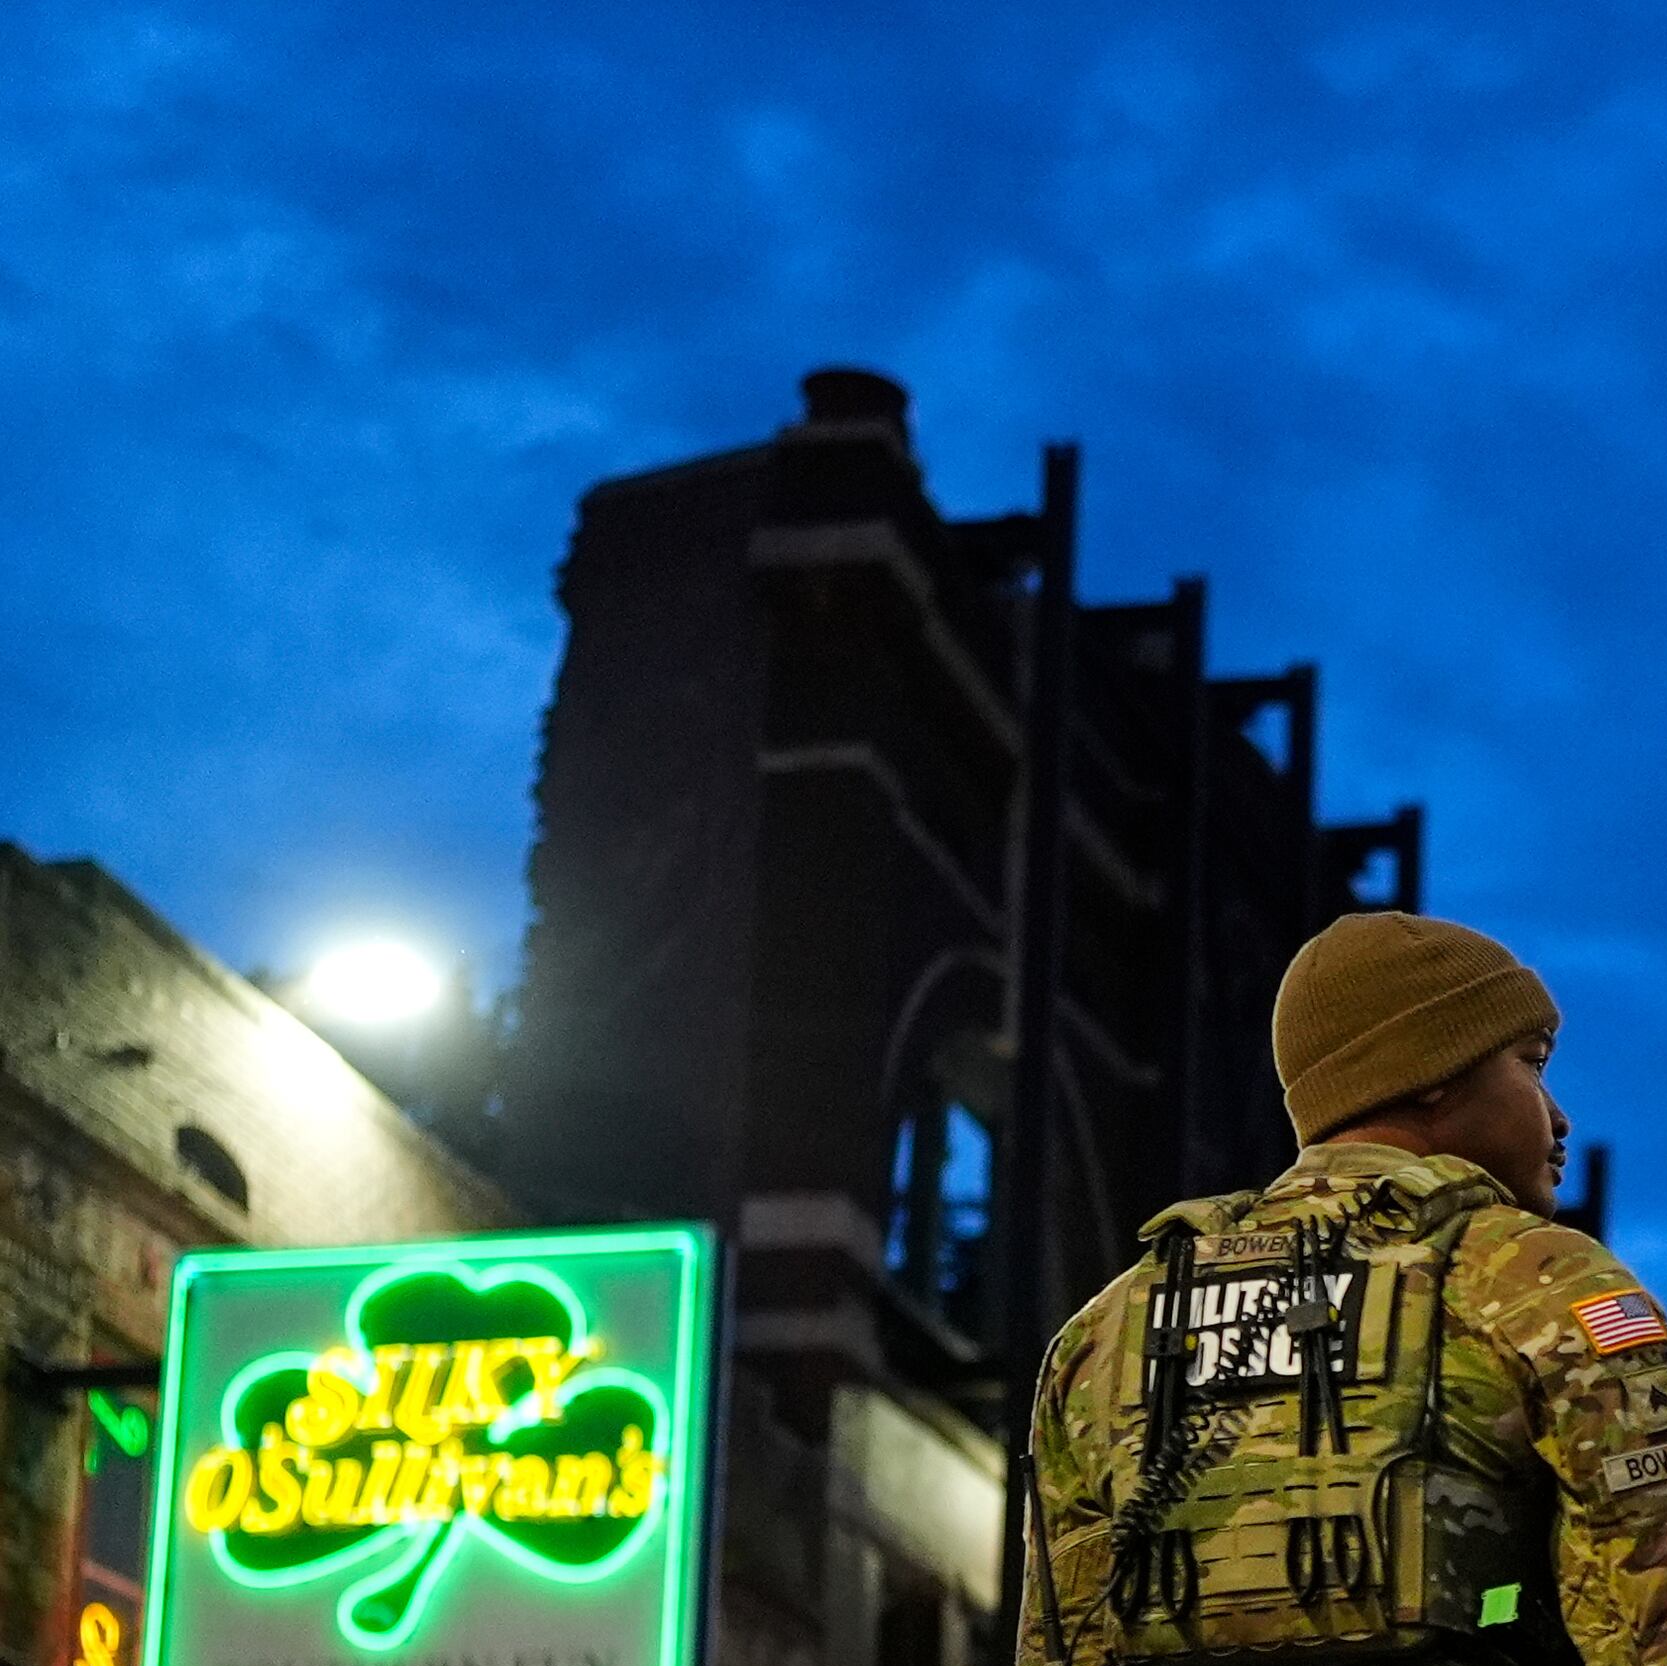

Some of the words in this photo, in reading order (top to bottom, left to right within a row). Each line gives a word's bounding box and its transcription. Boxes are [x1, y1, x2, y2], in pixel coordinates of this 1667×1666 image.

[1218, 1236, 1295, 1256] BOWEN
[285, 1336, 603, 1446] SILKY
[185, 1423, 666, 1534] O'Sullivan's
